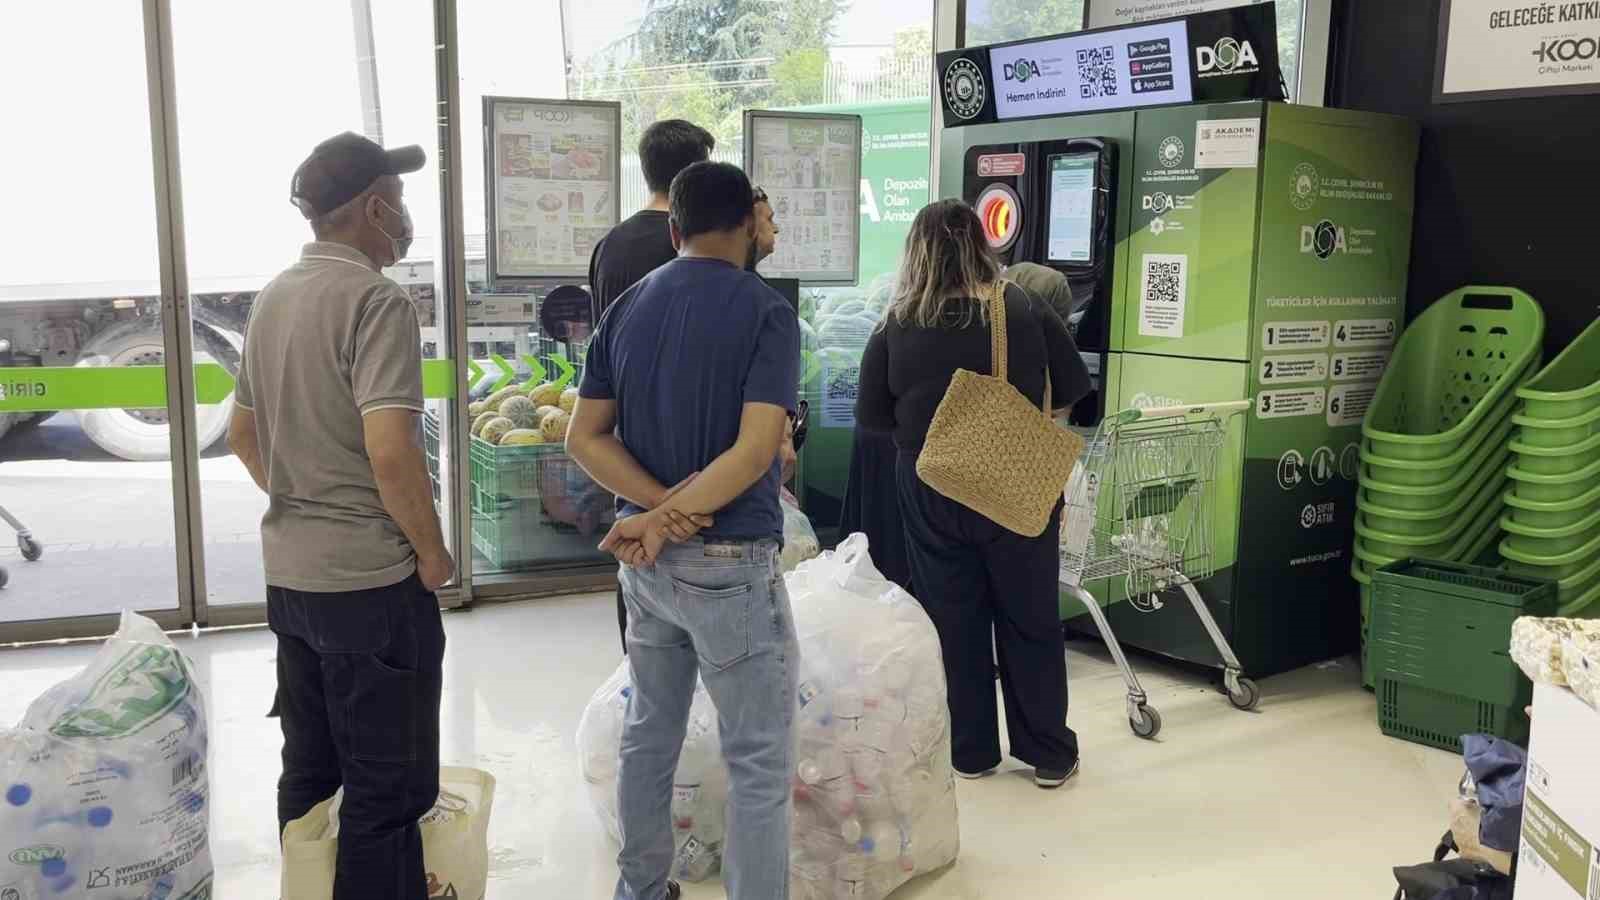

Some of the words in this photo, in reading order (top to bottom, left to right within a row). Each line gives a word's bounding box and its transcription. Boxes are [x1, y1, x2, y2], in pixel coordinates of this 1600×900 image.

[1489, 2, 1556, 29] GELECEĞE
[1558, 1, 1600, 22] KATKI
[1142, 61, 1170, 72] AppGallery
[1006, 91, 1035, 103] Hemen
[1036, 87, 1067, 100] İndirin!
[884, 194, 911, 206] Olan
[1267, 327, 1274, 345] 1
[1336, 325, 1347, 342] 4
[1263, 361, 1274, 378] 2
[1334, 359, 1343, 376] 5
[1261, 395, 1271, 413] 3
[1330, 397, 1340, 414] 6
